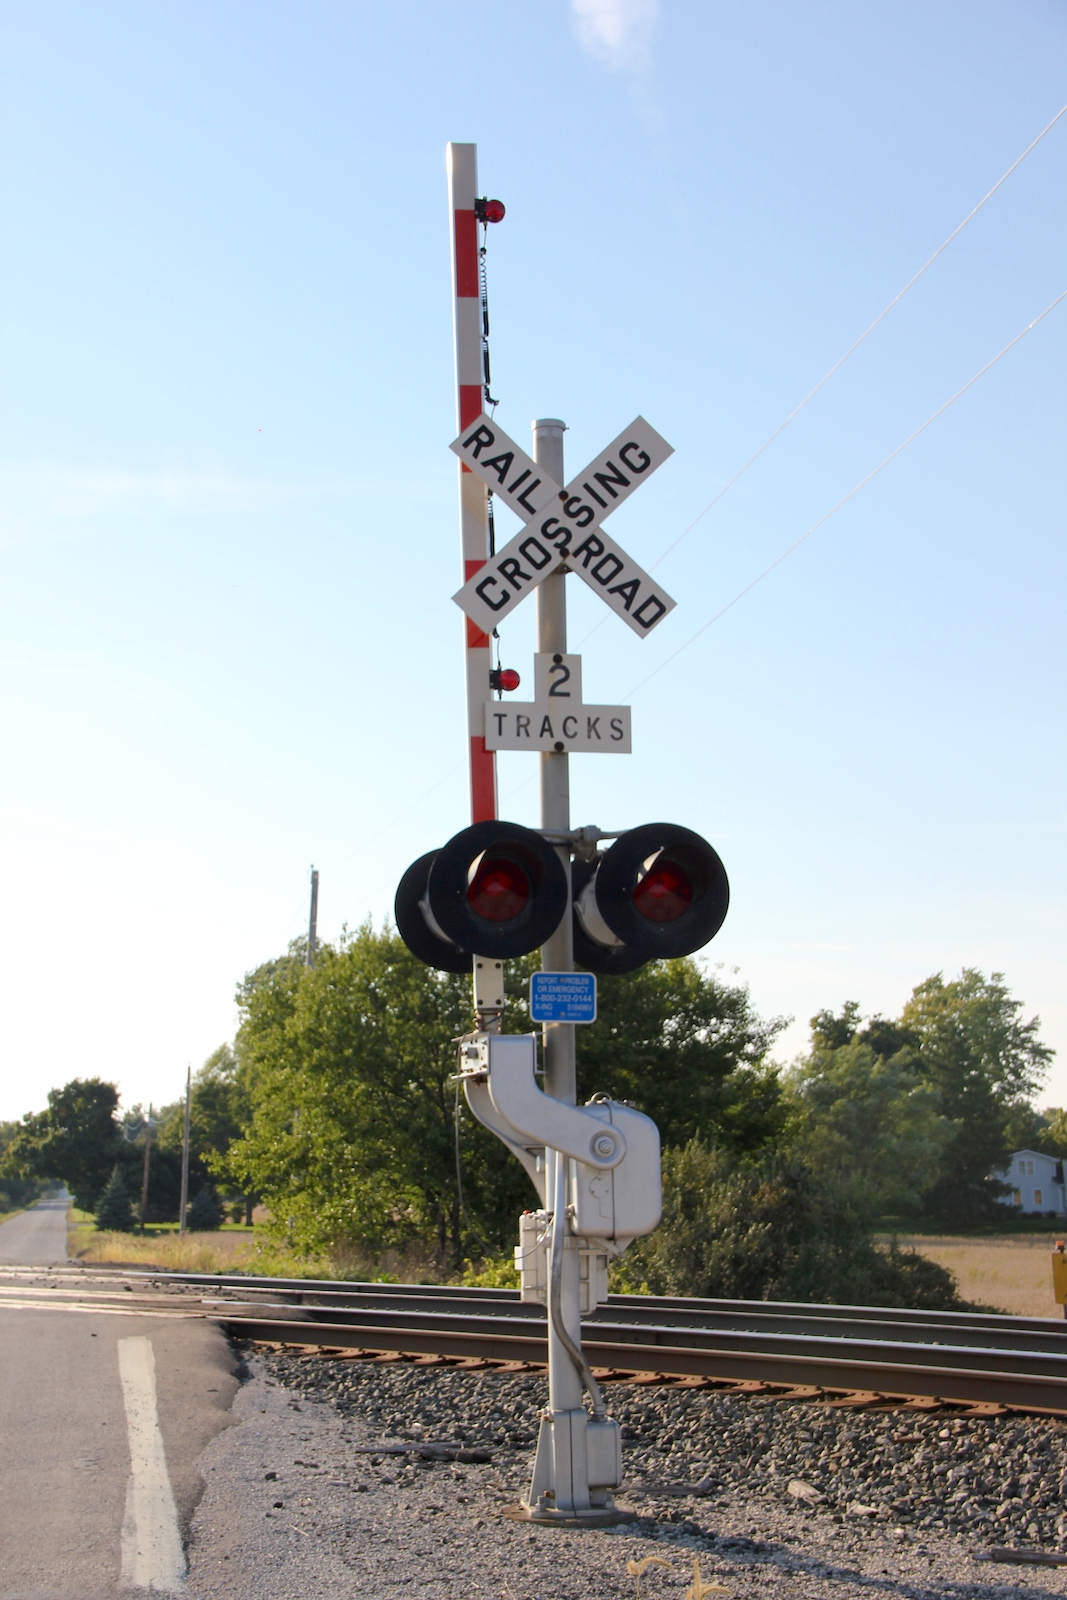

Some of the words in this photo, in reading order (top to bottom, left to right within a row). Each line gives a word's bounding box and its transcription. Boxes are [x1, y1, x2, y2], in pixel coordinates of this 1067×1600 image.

[462, 424, 543, 515] RAIL
[573, 535, 667, 629] ROAD
[475, 442, 651, 611] CROSSING
[549, 664, 571, 697] 2
[493, 713, 624, 741] TRACKS
[534, 994, 592, 1002] 1-800-232-0144
[548, 985, 589, 993] EMERGENCY
